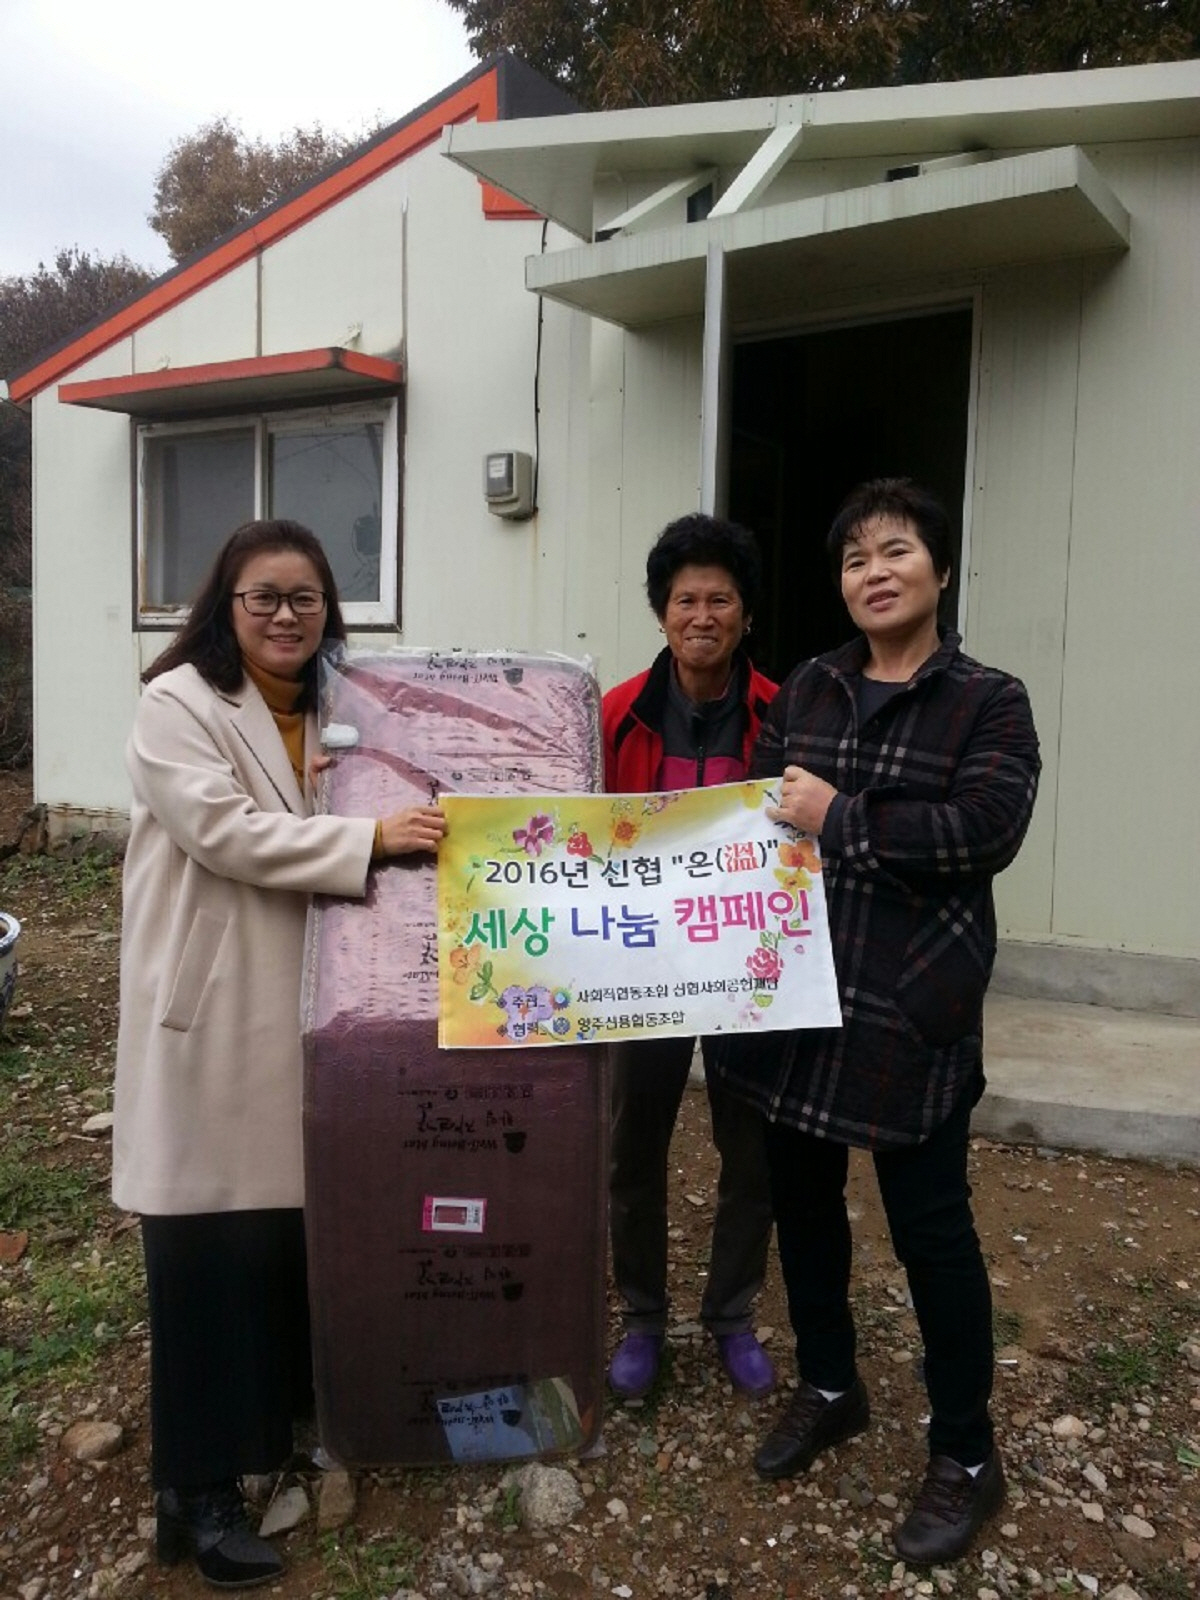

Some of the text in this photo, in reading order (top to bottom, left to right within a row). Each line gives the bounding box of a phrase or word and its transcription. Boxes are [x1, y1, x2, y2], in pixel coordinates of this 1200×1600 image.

[485, 860, 589, 888] 2016년
[601, 855, 662, 888] 신협
[464, 889, 812, 957] 세상 나눔 캠페인
[577, 984, 668, 1003] 사회적협동조합
[673, 977, 778, 998] 신협사회공헌재단
